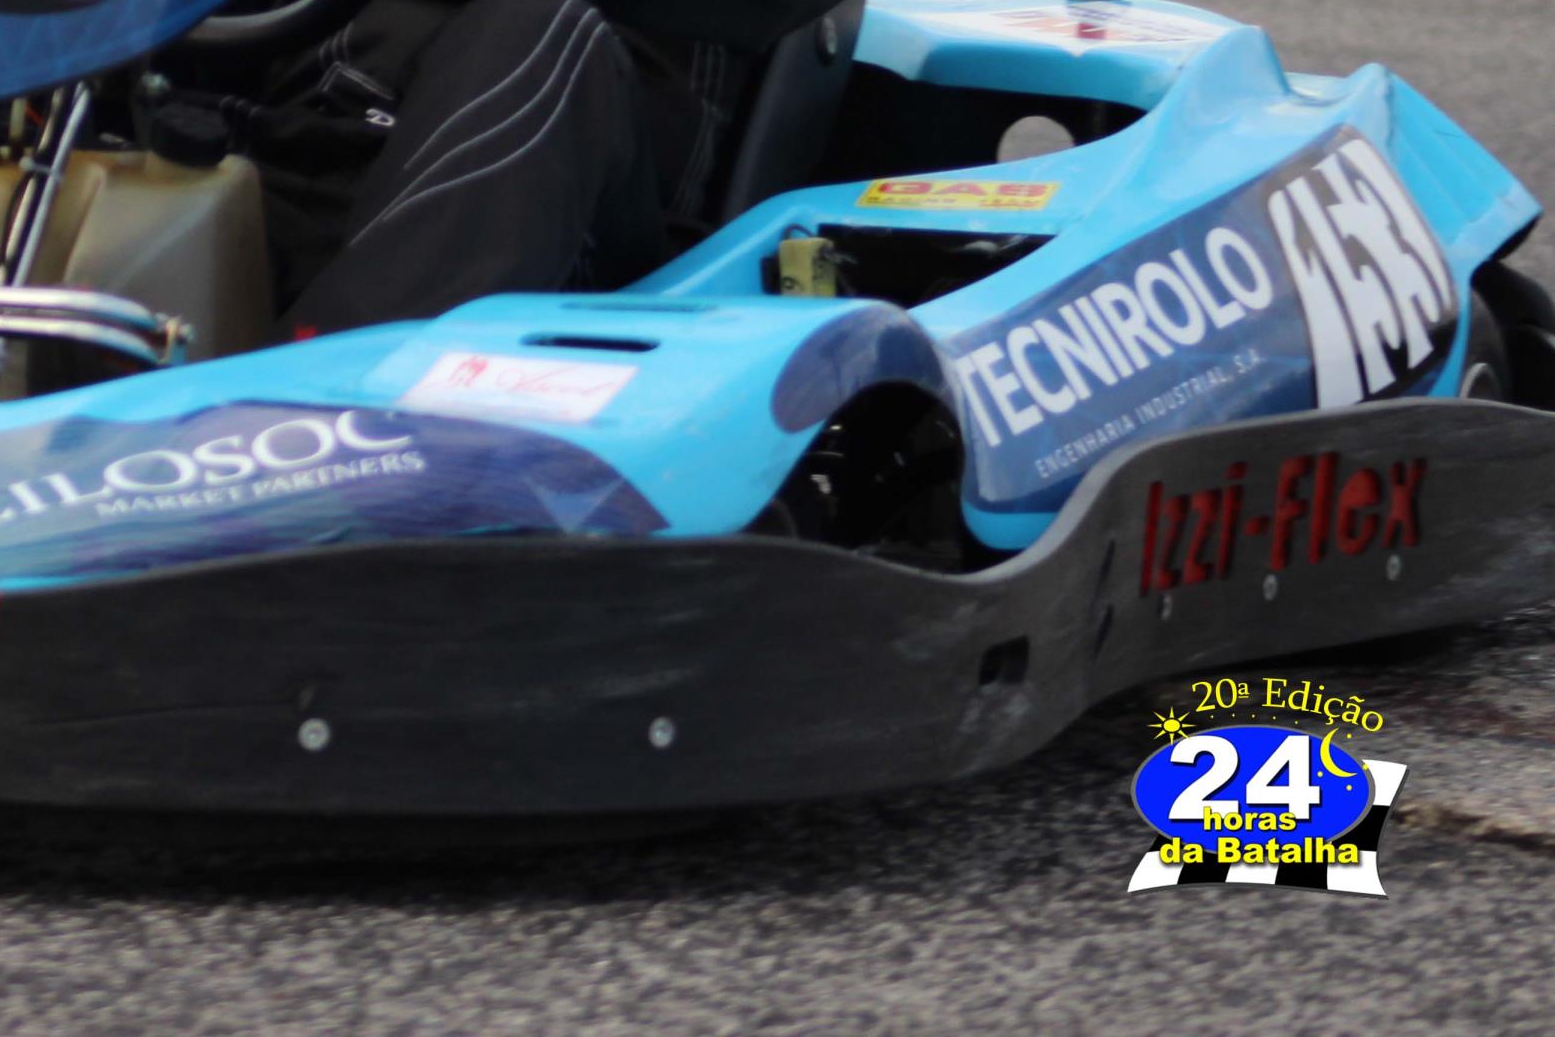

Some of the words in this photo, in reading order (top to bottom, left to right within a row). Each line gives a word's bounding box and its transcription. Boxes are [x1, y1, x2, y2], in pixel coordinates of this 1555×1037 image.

[953, 227, 1274, 448] TECNIROLO
[1035, 414, 1135, 478] ENGENHARIA
[95, 487, 242, 518] MARKET
[253, 451, 425, 496] PARTNERS
